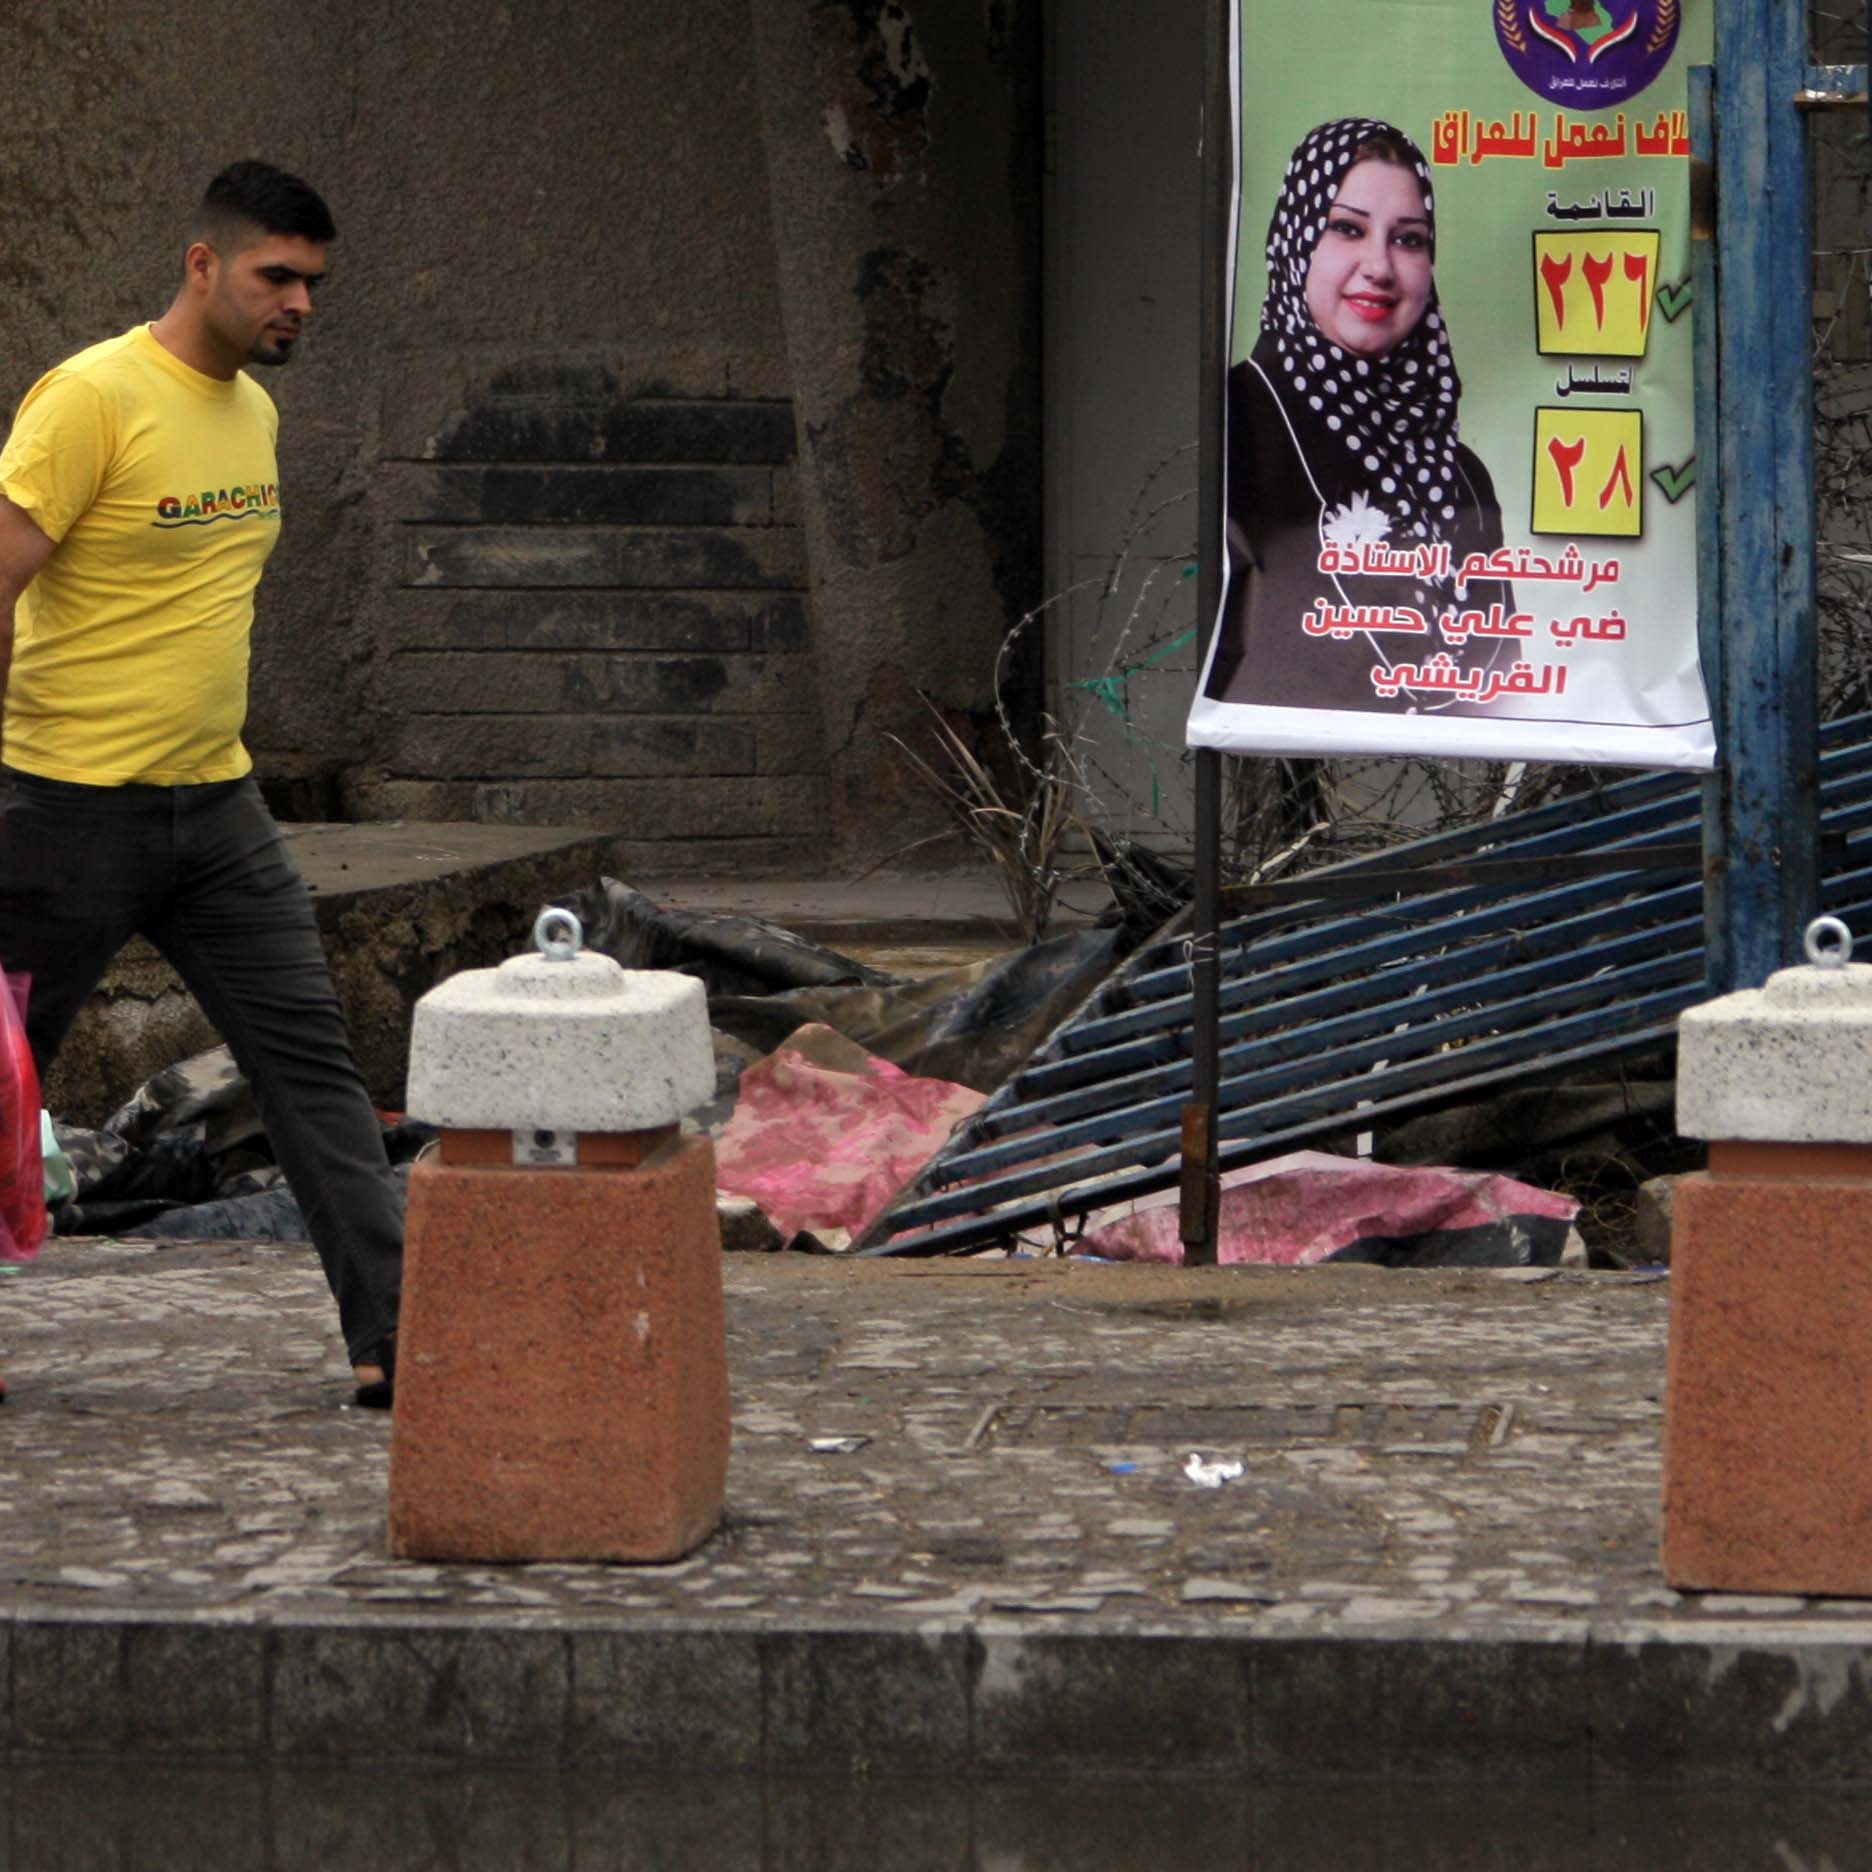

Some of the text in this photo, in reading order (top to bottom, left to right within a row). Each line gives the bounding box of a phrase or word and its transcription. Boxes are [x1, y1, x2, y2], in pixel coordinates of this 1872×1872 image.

[1432, 110, 1538, 166] للعراق
[1542, 111, 1627, 170] نعمل
[1539, 250, 1649, 333] ٢٢٦
[1547, 435, 1634, 511] ٢٨
[157, 483, 280, 520] GARACHIC
[1317, 541, 1621, 593] مرشحتكم الاستاذة
[1302, 598, 1427, 638] حسين
[1439, 604, 1535, 643] علي
[1371, 652, 1568, 702] القريشي
